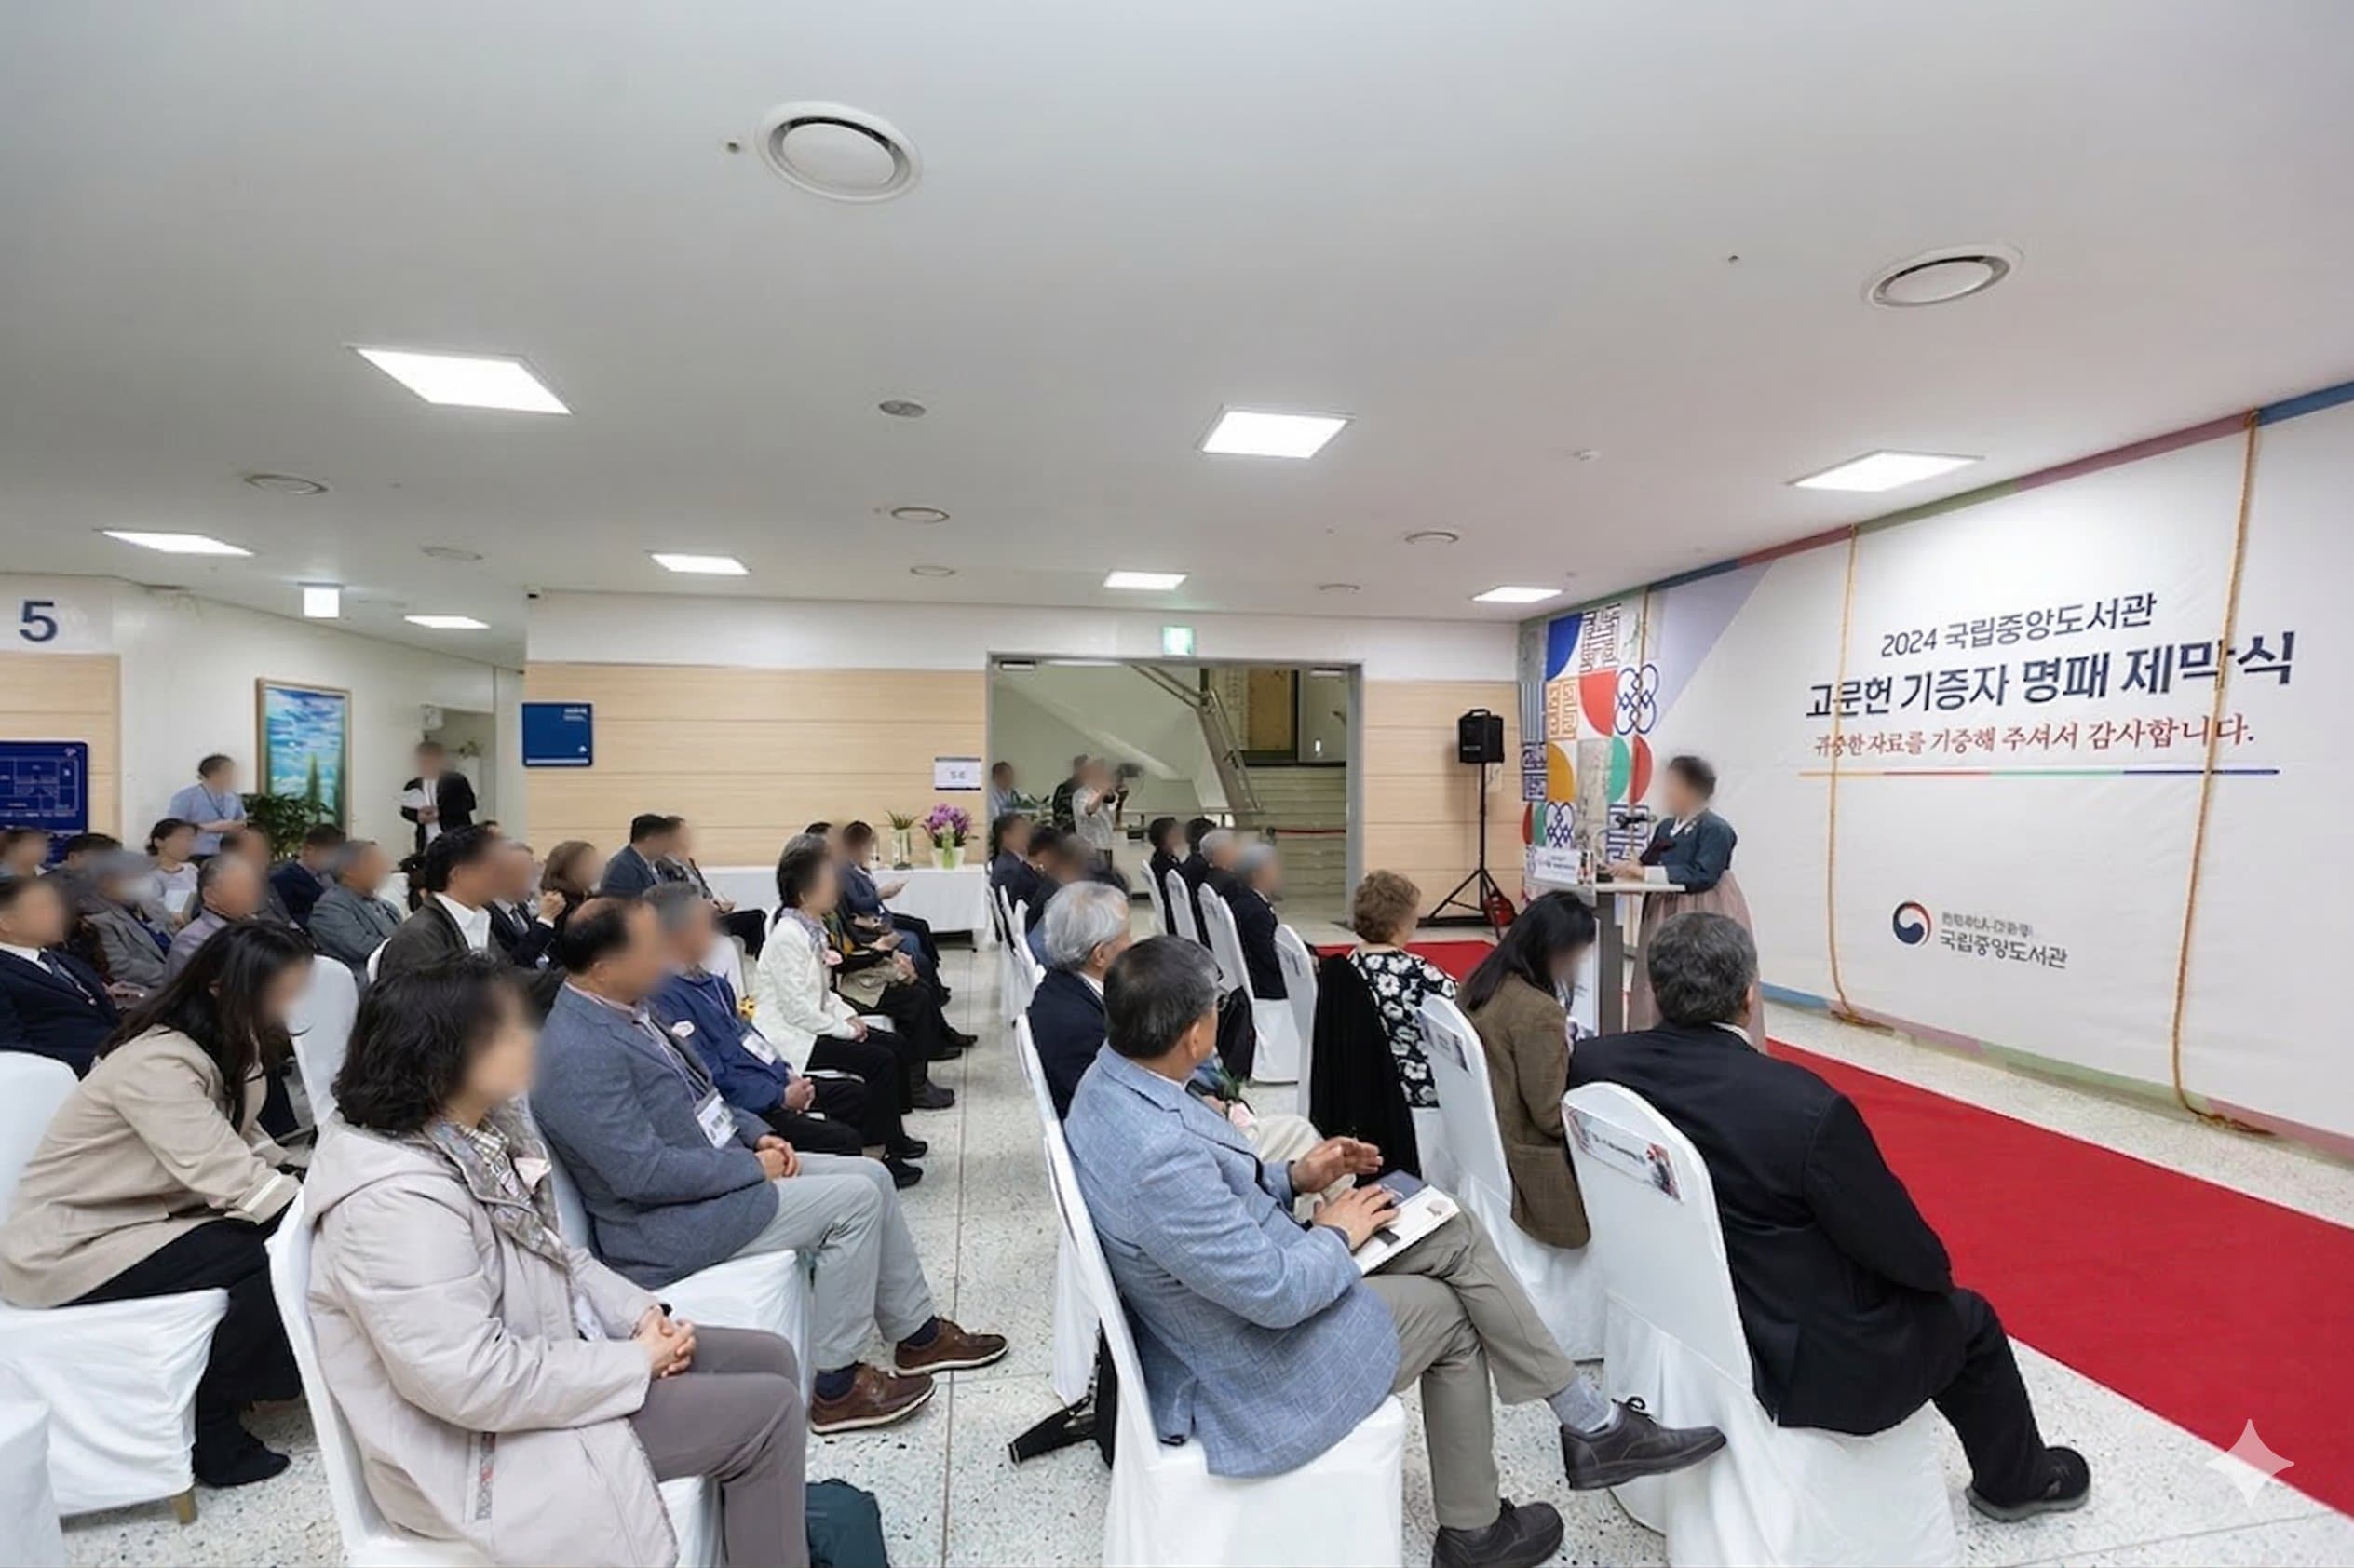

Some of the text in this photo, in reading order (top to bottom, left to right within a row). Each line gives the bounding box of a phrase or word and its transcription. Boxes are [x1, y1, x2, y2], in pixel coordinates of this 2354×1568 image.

[20, 601, 58, 642] 5
[1881, 592, 2158, 656] 2024 국립중앙도서관
[1806, 631, 2295, 718] 고문헌 기증자 명패 제막식
[1930, 726, 1996, 754] 기증해
[2002, 722, 2078, 752] 주셔서
[2088, 712, 2255, 750] 감사합니다.
[1940, 928, 2068, 969] 국립중앙도서관
